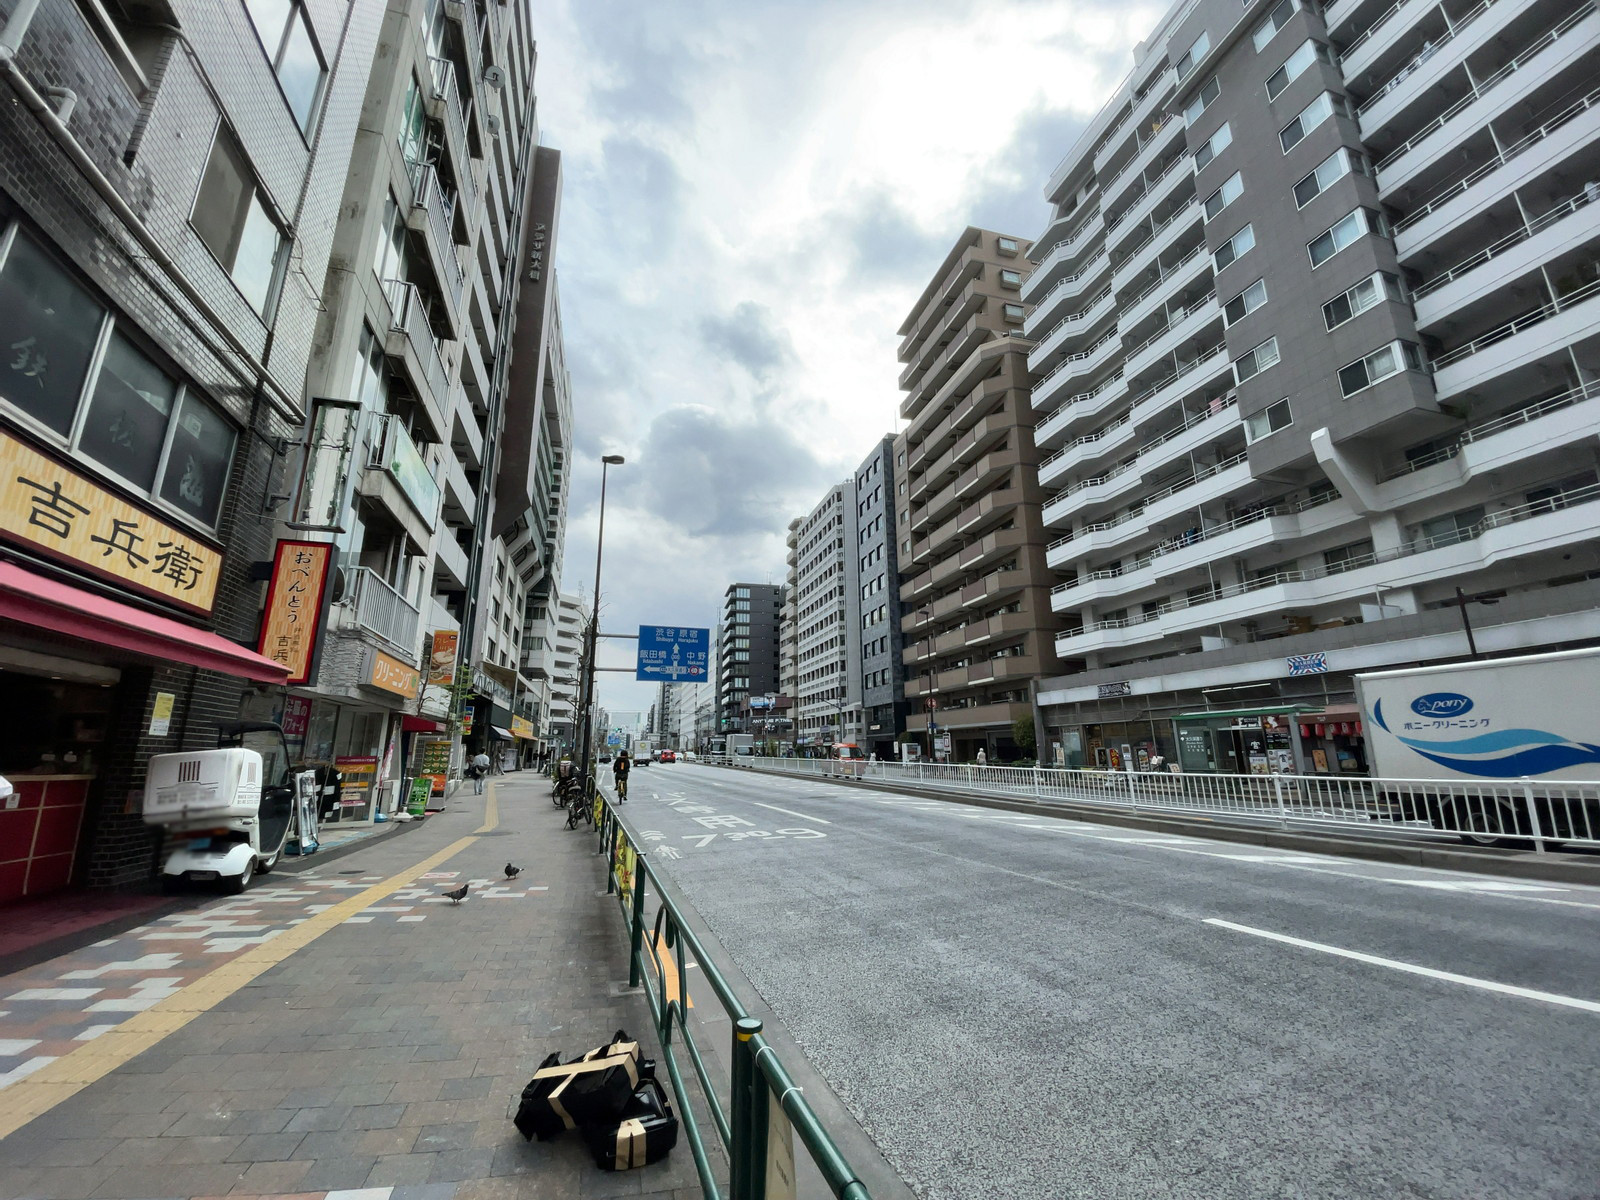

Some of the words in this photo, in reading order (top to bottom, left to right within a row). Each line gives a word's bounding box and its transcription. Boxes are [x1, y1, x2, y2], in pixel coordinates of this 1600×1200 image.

[16, 475, 205, 591] 吉兵衛
[287, 551, 313, 624] おべんとう
[656, 628, 675, 637] 渋谷
[679, 629, 698, 638] 原宿
[273, 635, 292, 666] 吉兵
[640, 650, 667, 659] 飯田橋
[687, 651, 706, 660] 中野
[375, 659, 412, 690] クリーニング
[1431, 698, 1468, 711] pony
[1403, 718, 1490, 730] ポニークリーニング
